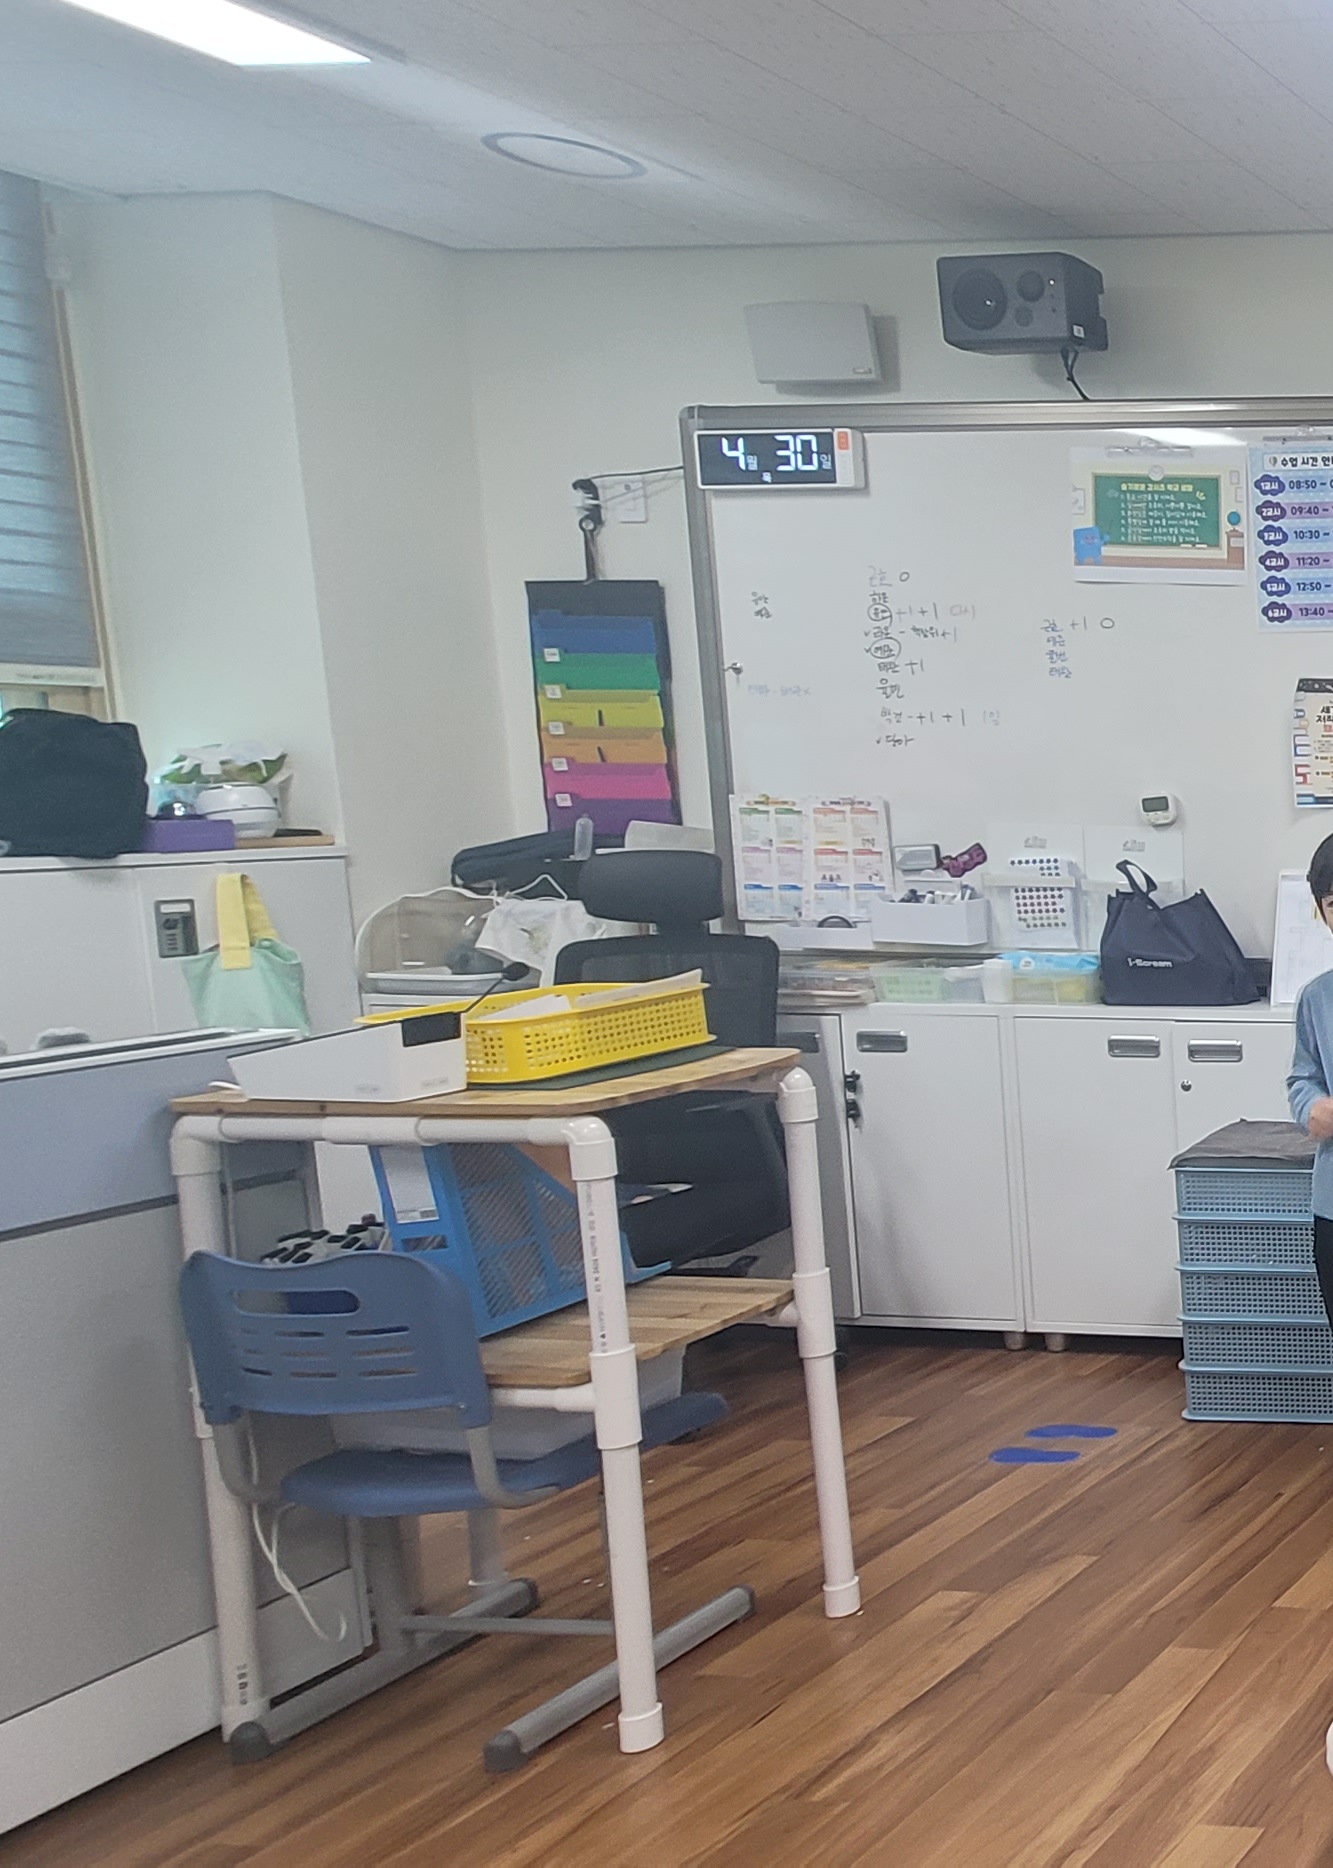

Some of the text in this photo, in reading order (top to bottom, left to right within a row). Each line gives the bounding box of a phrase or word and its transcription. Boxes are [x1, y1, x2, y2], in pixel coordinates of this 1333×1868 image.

[1281, 456, 1298, 467] 수업
[1301, 456, 1318, 467] 시간
[1288, 479, 1317, 489] 08:50
[1290, 506, 1319, 515] 09:40
[1293, 529, 1320, 540] 10:30
[1296, 556, 1320, 566] 11:20
[1296, 581, 1322, 591] 12:50
[1299, 606, 1325, 616] 13:40
